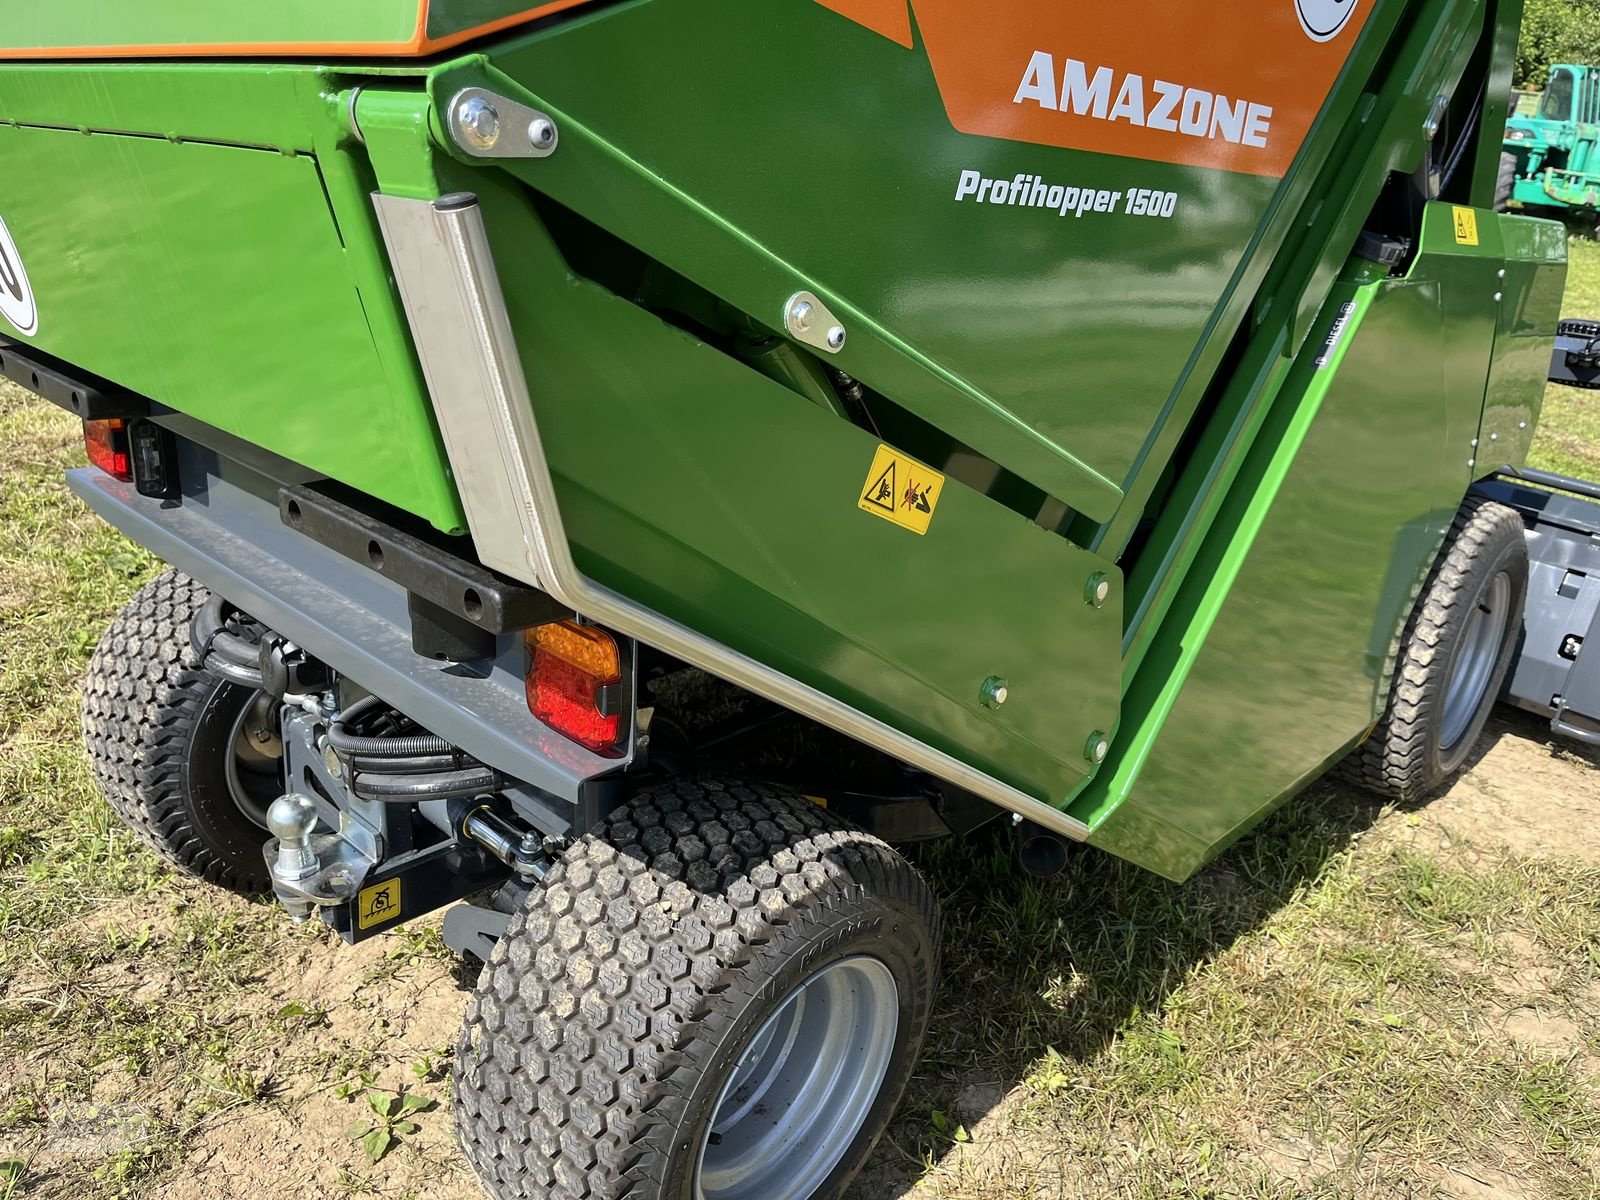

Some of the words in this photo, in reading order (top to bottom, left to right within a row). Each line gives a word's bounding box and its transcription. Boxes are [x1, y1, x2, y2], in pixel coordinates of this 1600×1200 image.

[1012, 50, 1273, 148] AMAZONE
[954, 169, 1122, 218] Profihopper
[1124, 188, 1178, 218] 1500
[1325, 315, 1349, 346] DIESEL
